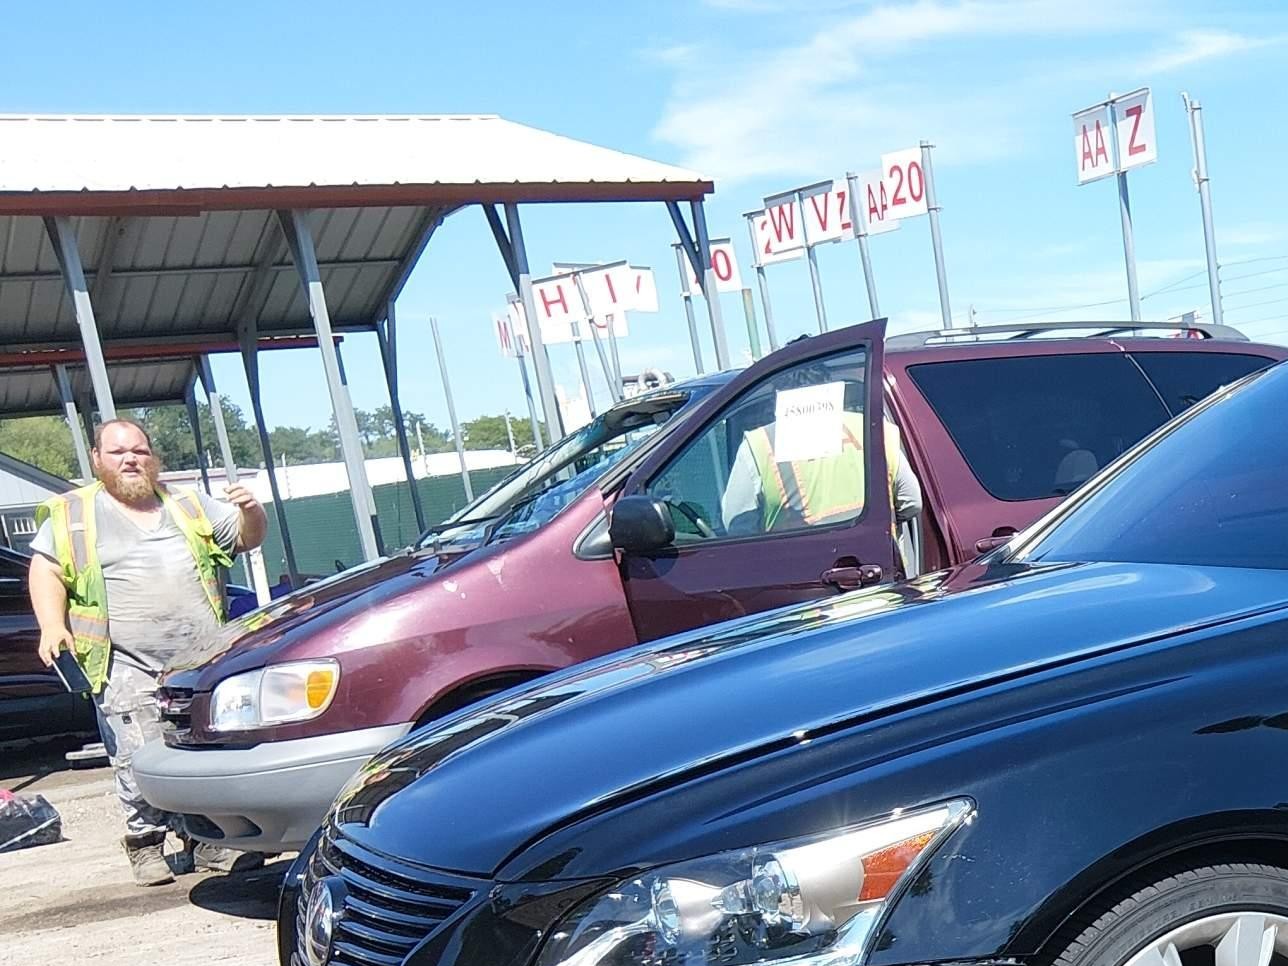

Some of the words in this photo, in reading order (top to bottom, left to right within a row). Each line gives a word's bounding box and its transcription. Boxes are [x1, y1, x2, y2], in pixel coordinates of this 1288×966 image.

[1081, 124, 1108, 171] AA
[1126, 105, 1146, 156] Z
[888, 160, 924, 206] 20
[769, 201, 794, 243] W
[811, 192, 829, 232] V
[539, 284, 569, 318] H
